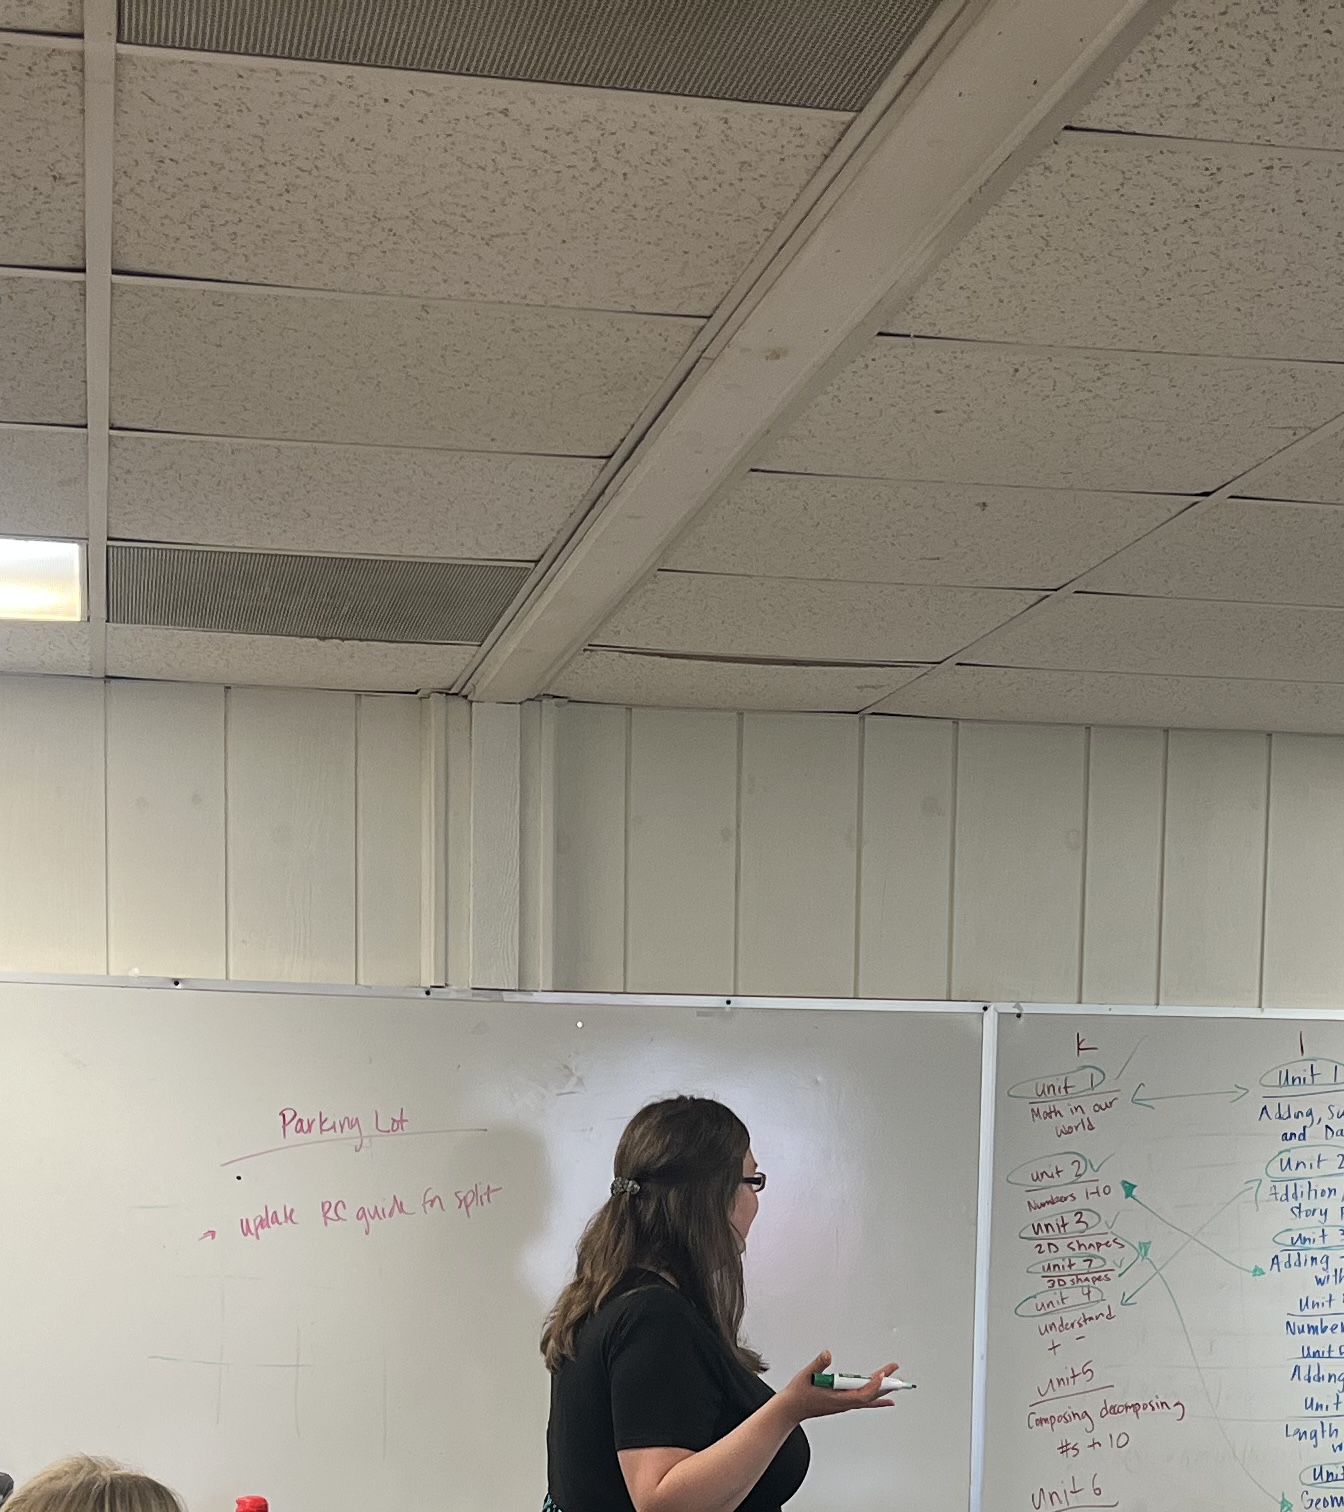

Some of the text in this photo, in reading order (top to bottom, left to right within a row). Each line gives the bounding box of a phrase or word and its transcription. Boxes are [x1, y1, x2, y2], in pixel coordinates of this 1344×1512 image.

[1030, 1097, 1119, 1122] Math in our
[278, 1107, 409, 1153] Parking Lot
[1281, 1126, 1307, 1142] and
[1071, 1159, 1082, 1178] 2
[320, 1199, 348, 1227] RC
[355, 1194, 416, 1236] guide
[454, 1182, 503, 1219] split
[1290, 1202, 1329, 1224] story
[1034, 1241, 1060, 1255] 2D
[1269, 1253, 1330, 1272] Adding
[1046, 1278, 1067, 1289] 3D
[1081, 1284, 1092, 1301] 4
[1081, 1360, 1094, 1383] 5
[1108, 1431, 1131, 1449] 10
[1285, 1420, 1340, 1448] Length
[1091, 1472, 1102, 1497] 6
